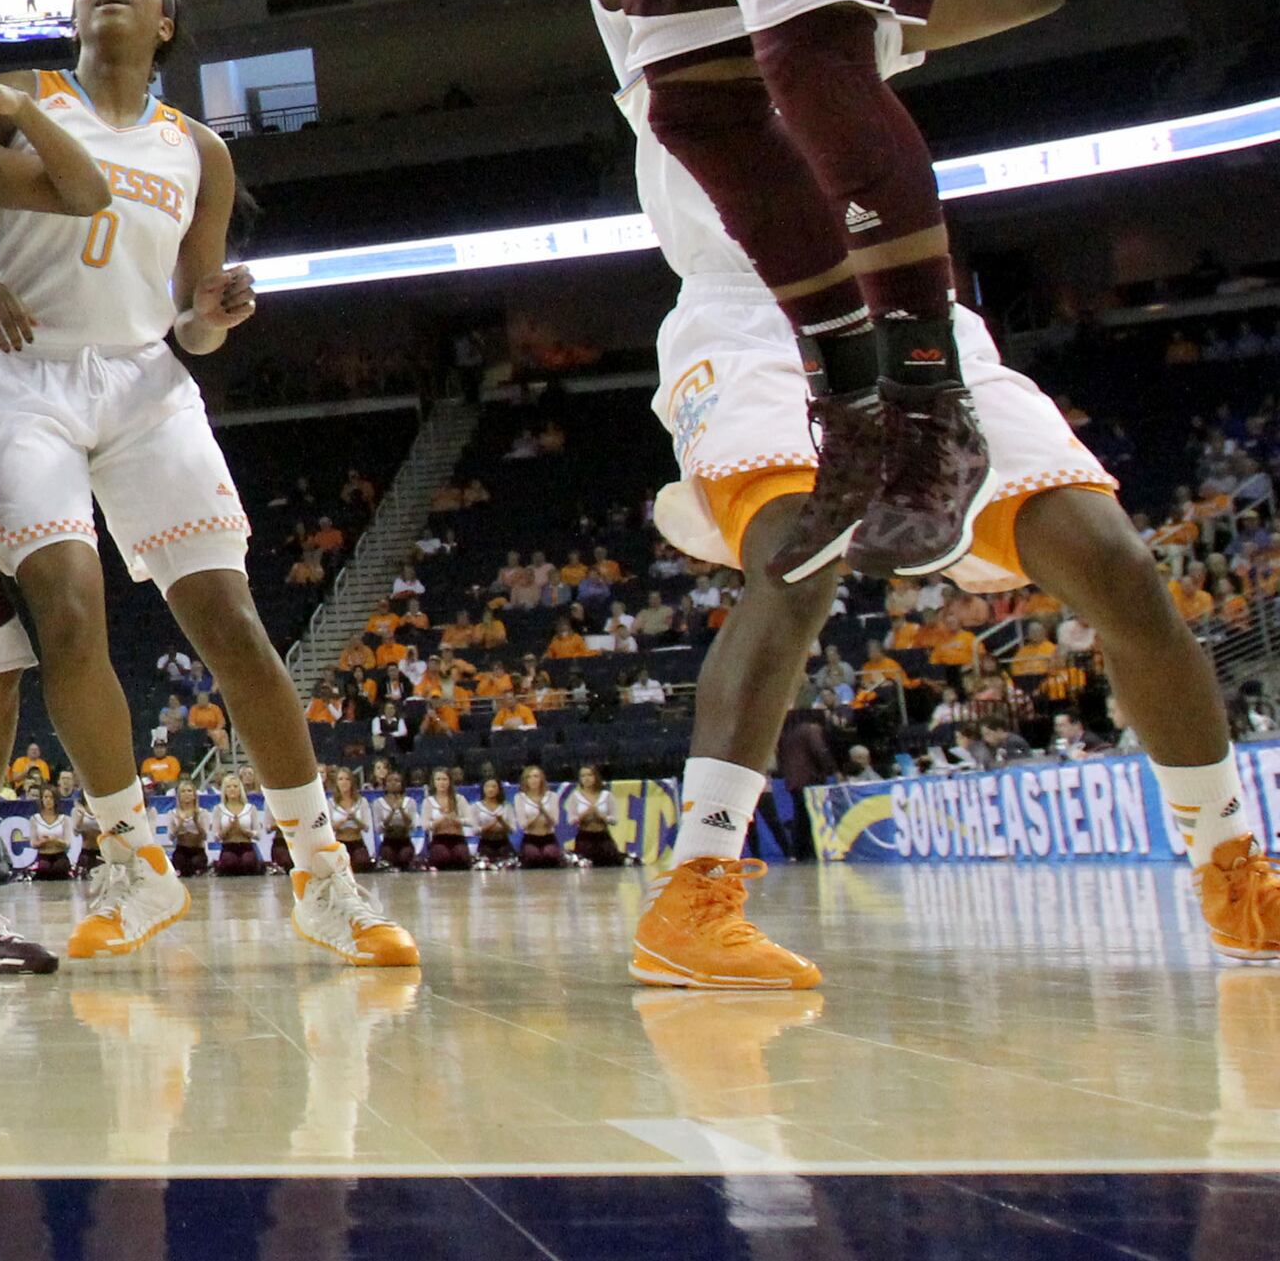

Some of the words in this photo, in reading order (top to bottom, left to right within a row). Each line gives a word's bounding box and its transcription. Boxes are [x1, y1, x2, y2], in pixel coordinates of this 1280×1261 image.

[98, 160, 185, 224] ESSEE
[81, 210, 119, 268] 0
[891, 761, 1151, 858] SOUTHEASTERN
